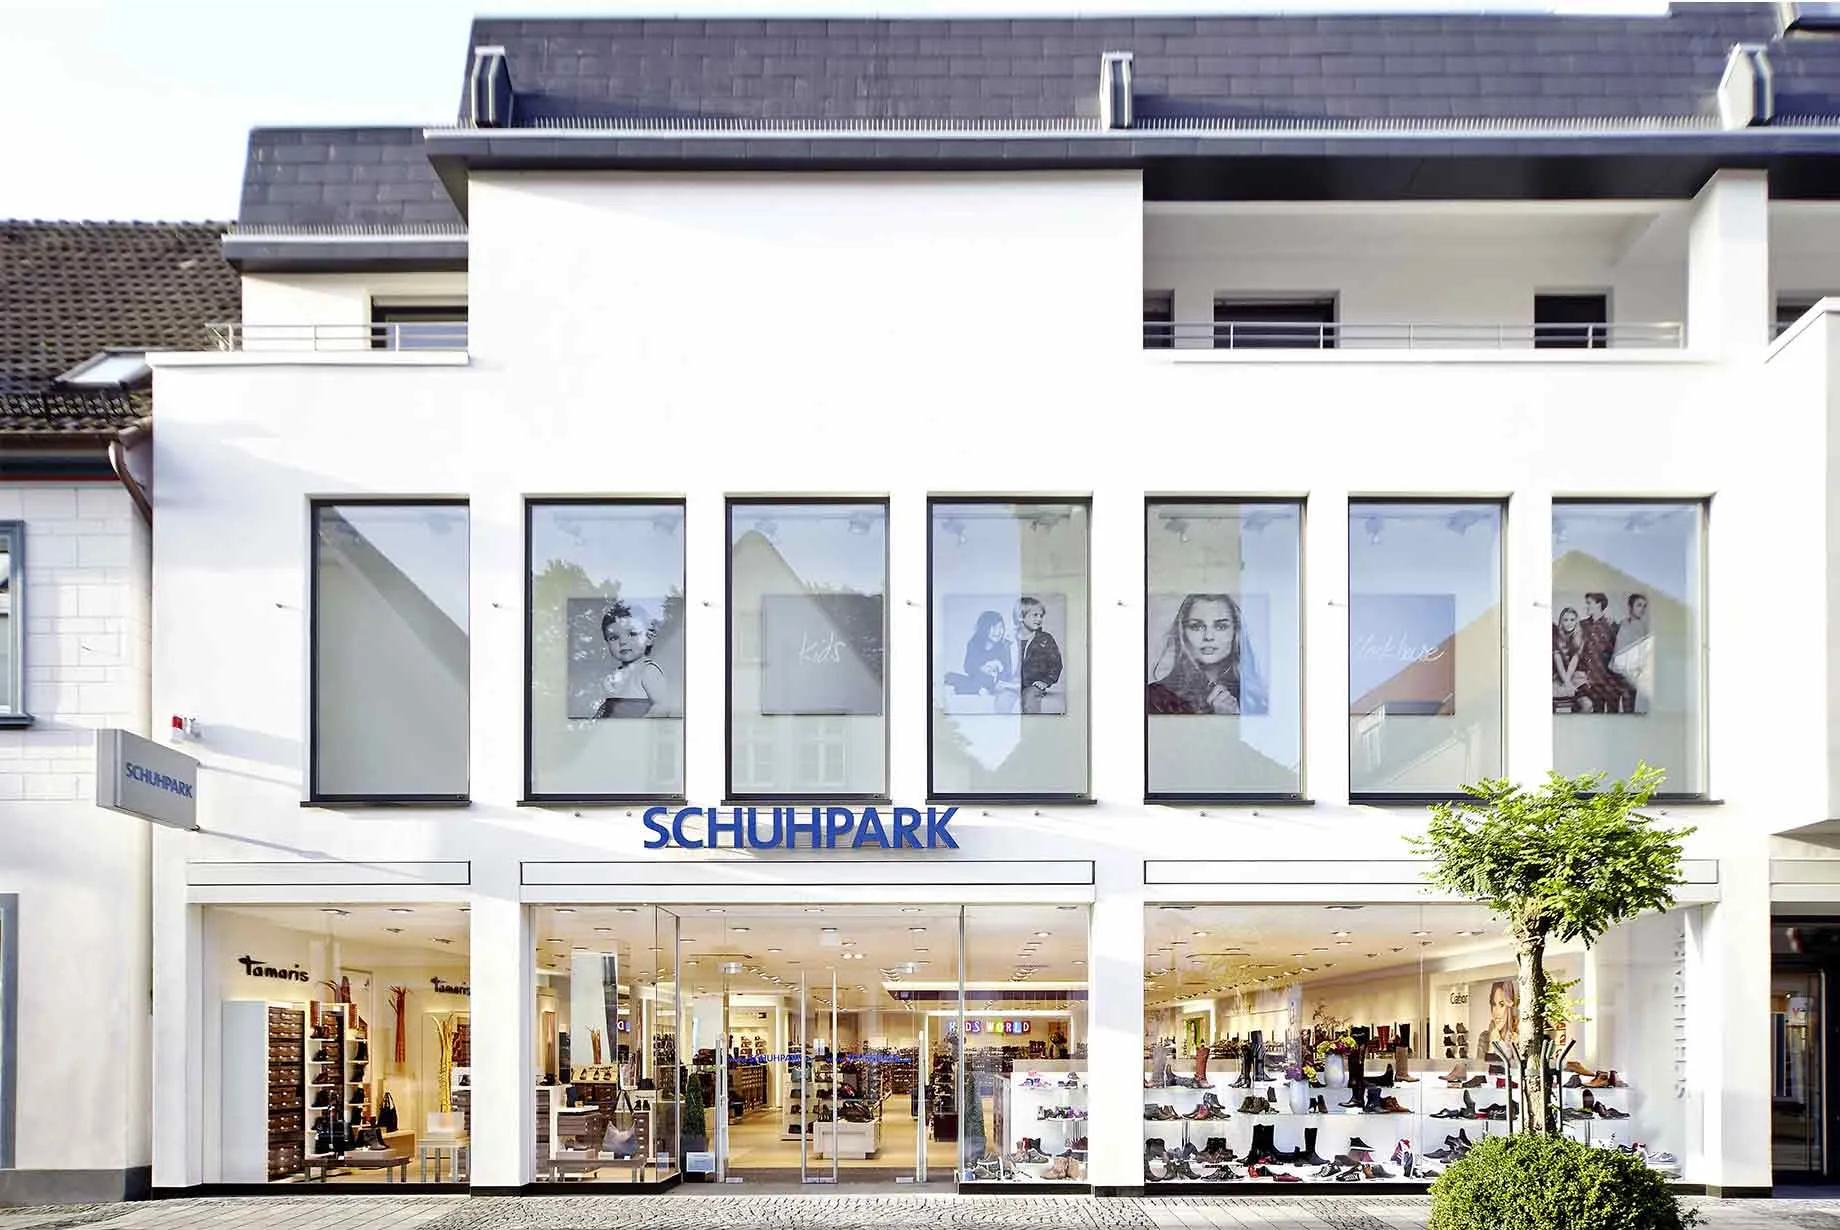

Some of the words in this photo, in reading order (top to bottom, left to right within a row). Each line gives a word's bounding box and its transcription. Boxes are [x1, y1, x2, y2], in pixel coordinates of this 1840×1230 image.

[126, 762, 193, 798] SCHUHPARK
[643, 806, 960, 848] SCHUHPARK
[238, 955, 309, 982] Tamaris
